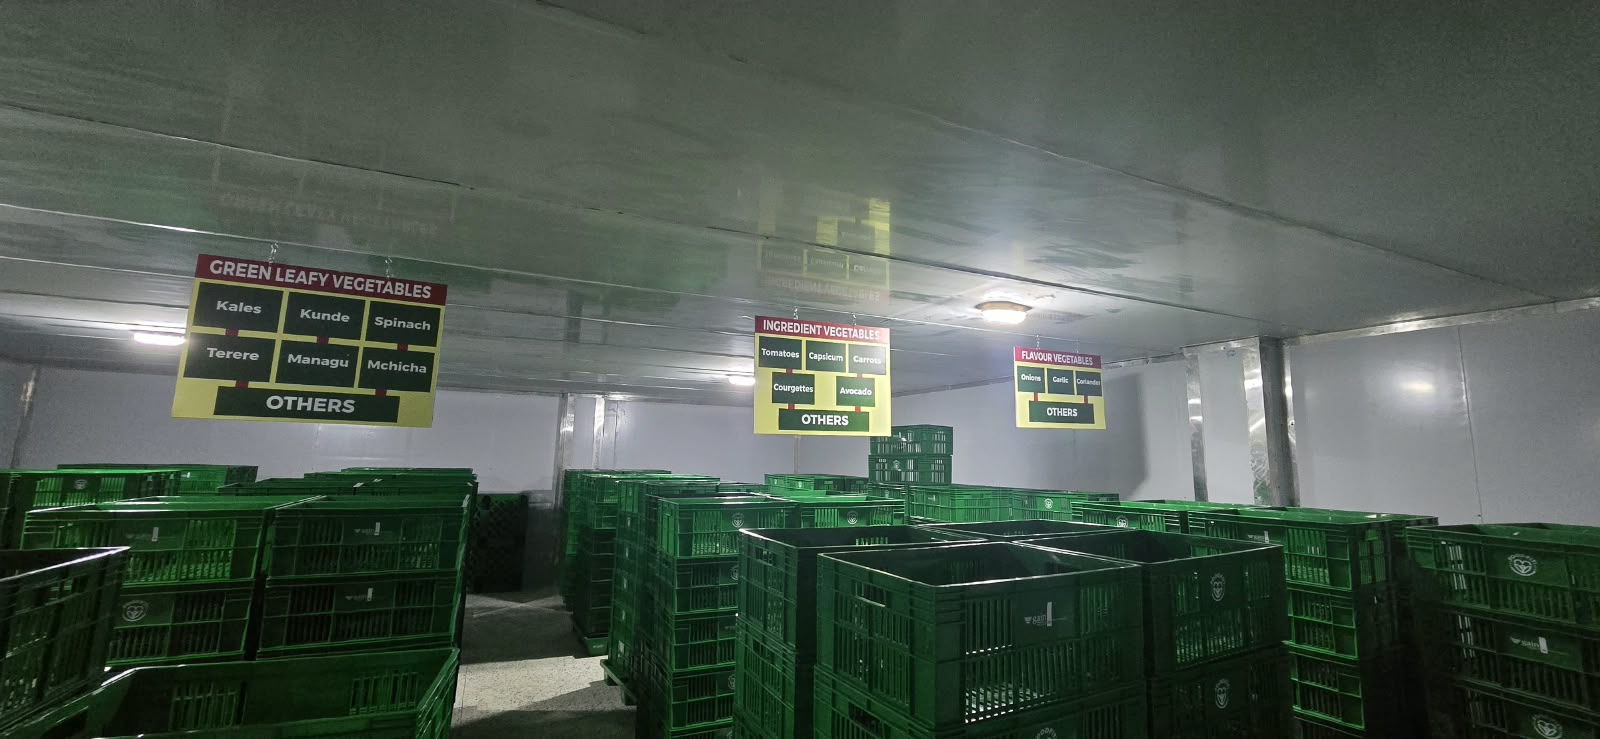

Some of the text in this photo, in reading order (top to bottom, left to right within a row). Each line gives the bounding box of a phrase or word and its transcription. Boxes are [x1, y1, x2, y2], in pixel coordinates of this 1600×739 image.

[209, 259, 432, 299] GREEN LEAFY VEGETABLES
[216, 300, 262, 315] Kales
[300, 308, 350, 323] Kunde
[374, 316, 431, 331] Spinach
[763, 319, 880, 340] INGREDIENT VEGETABLES
[206, 347, 260, 361] Terere
[761, 348, 800, 358] Tomatoes
[808, 352, 844, 362] Capsicum
[853, 355, 882, 365] Carrots
[1021, 350, 1093, 366] FLAVOUR VEGETABLES
[287, 353, 349, 369] Managu
[367, 360, 427, 374] Mchicha
[1021, 374, 1041, 382] Onions
[1053, 376, 1068, 384] Garlic
[773, 383, 814, 394] Courgettes
[839, 387, 873, 396] Avocado
[266, 395, 356, 414] OTHERS
[1046, 407, 1078, 417] OTHERS
[801, 414, 849, 426] OTHERS
